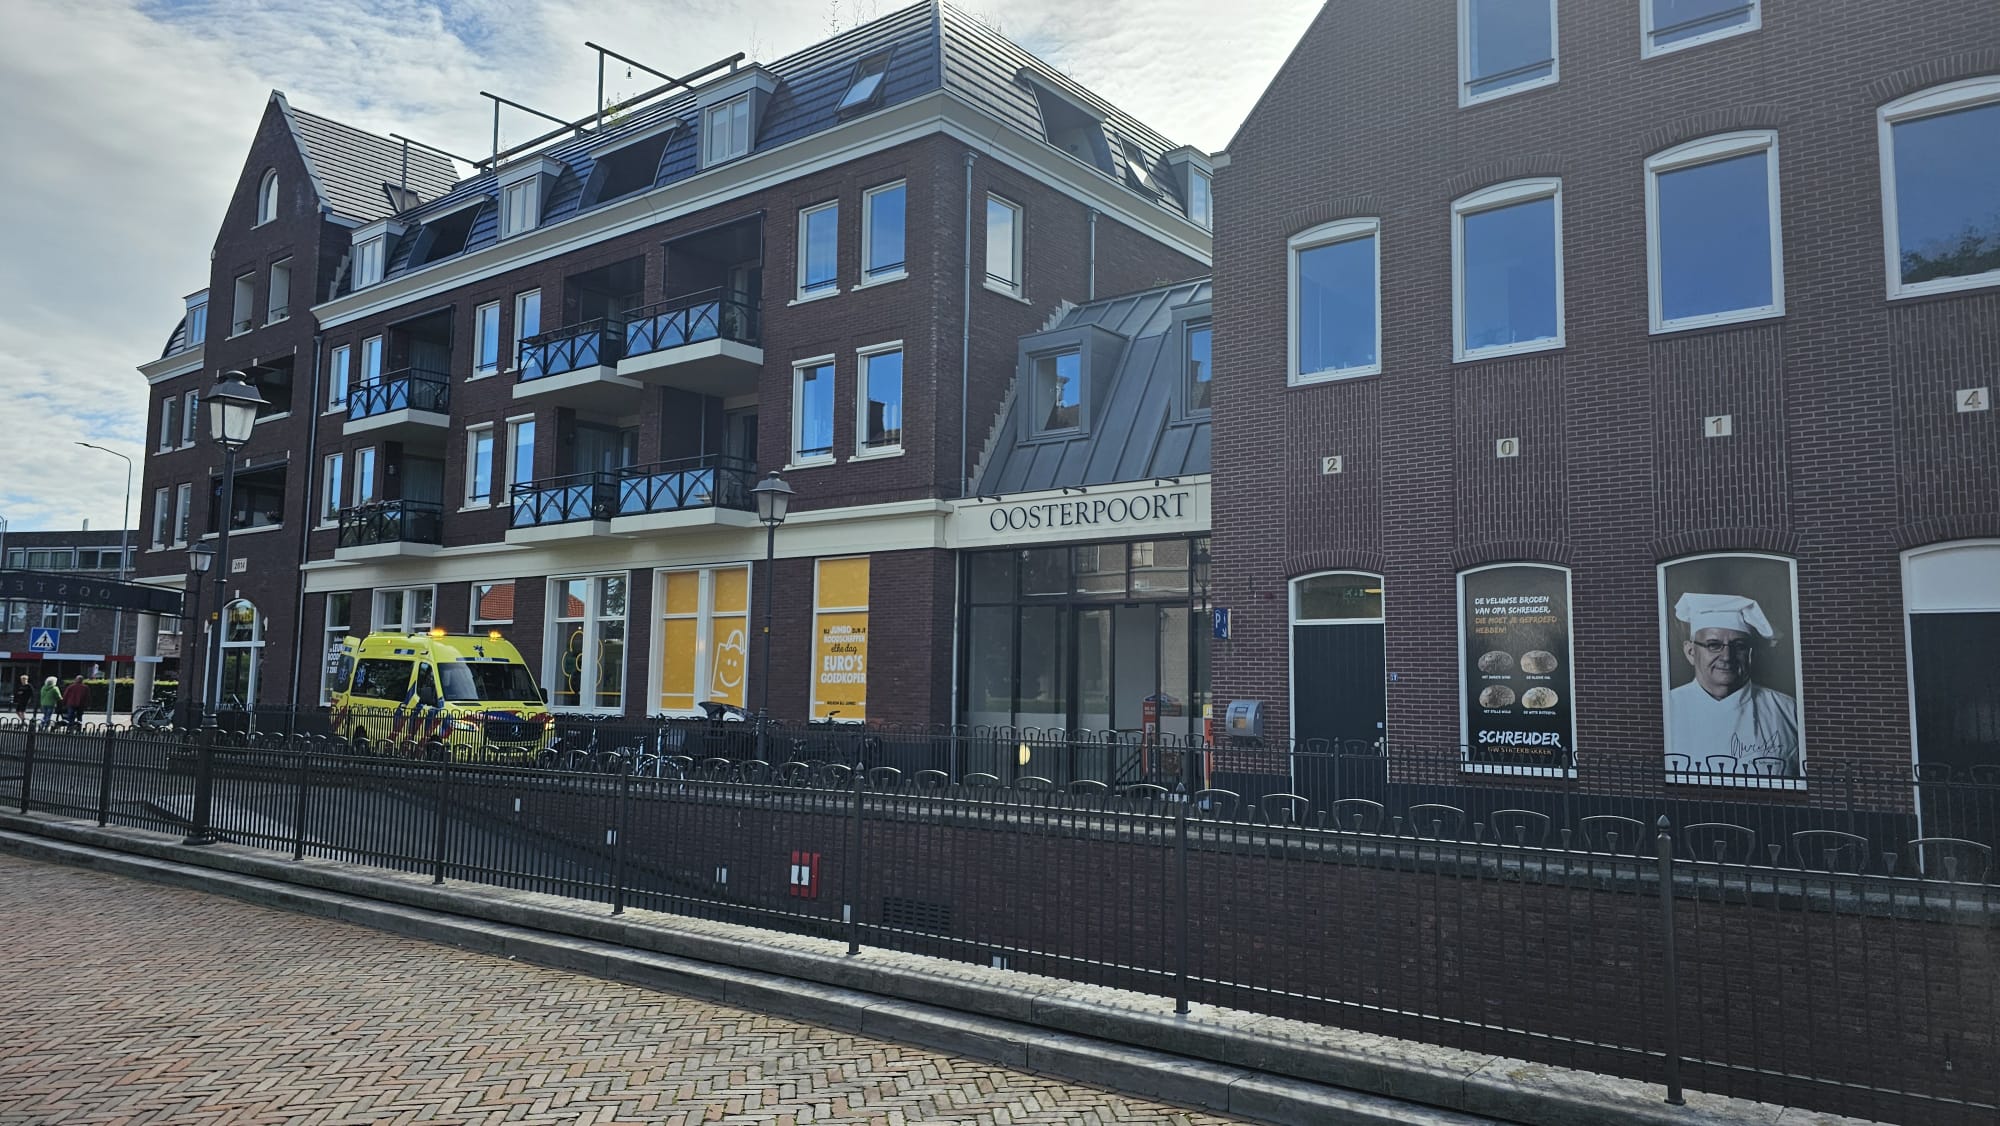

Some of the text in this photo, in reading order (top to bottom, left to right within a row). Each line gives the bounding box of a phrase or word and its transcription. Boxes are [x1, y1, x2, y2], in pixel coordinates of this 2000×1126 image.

[1326, 390, 1982, 473] 2 0 1 4
[990, 492, 1189, 532] OOSTERPOORT
[1474, 596, 1549, 605] DE VELUWSE BRODEN
[1475, 607, 1490, 615] VAN
[1491, 606, 1507, 614] OPA
[1519, 615, 1558, 624] GEPROEFD
[844, 643, 857, 655] dag
[823, 655, 863, 671] EURO'S
[820, 672, 866, 684] GOEDKOPER
[1478, 730, 1561, 748] SCHREUDER
